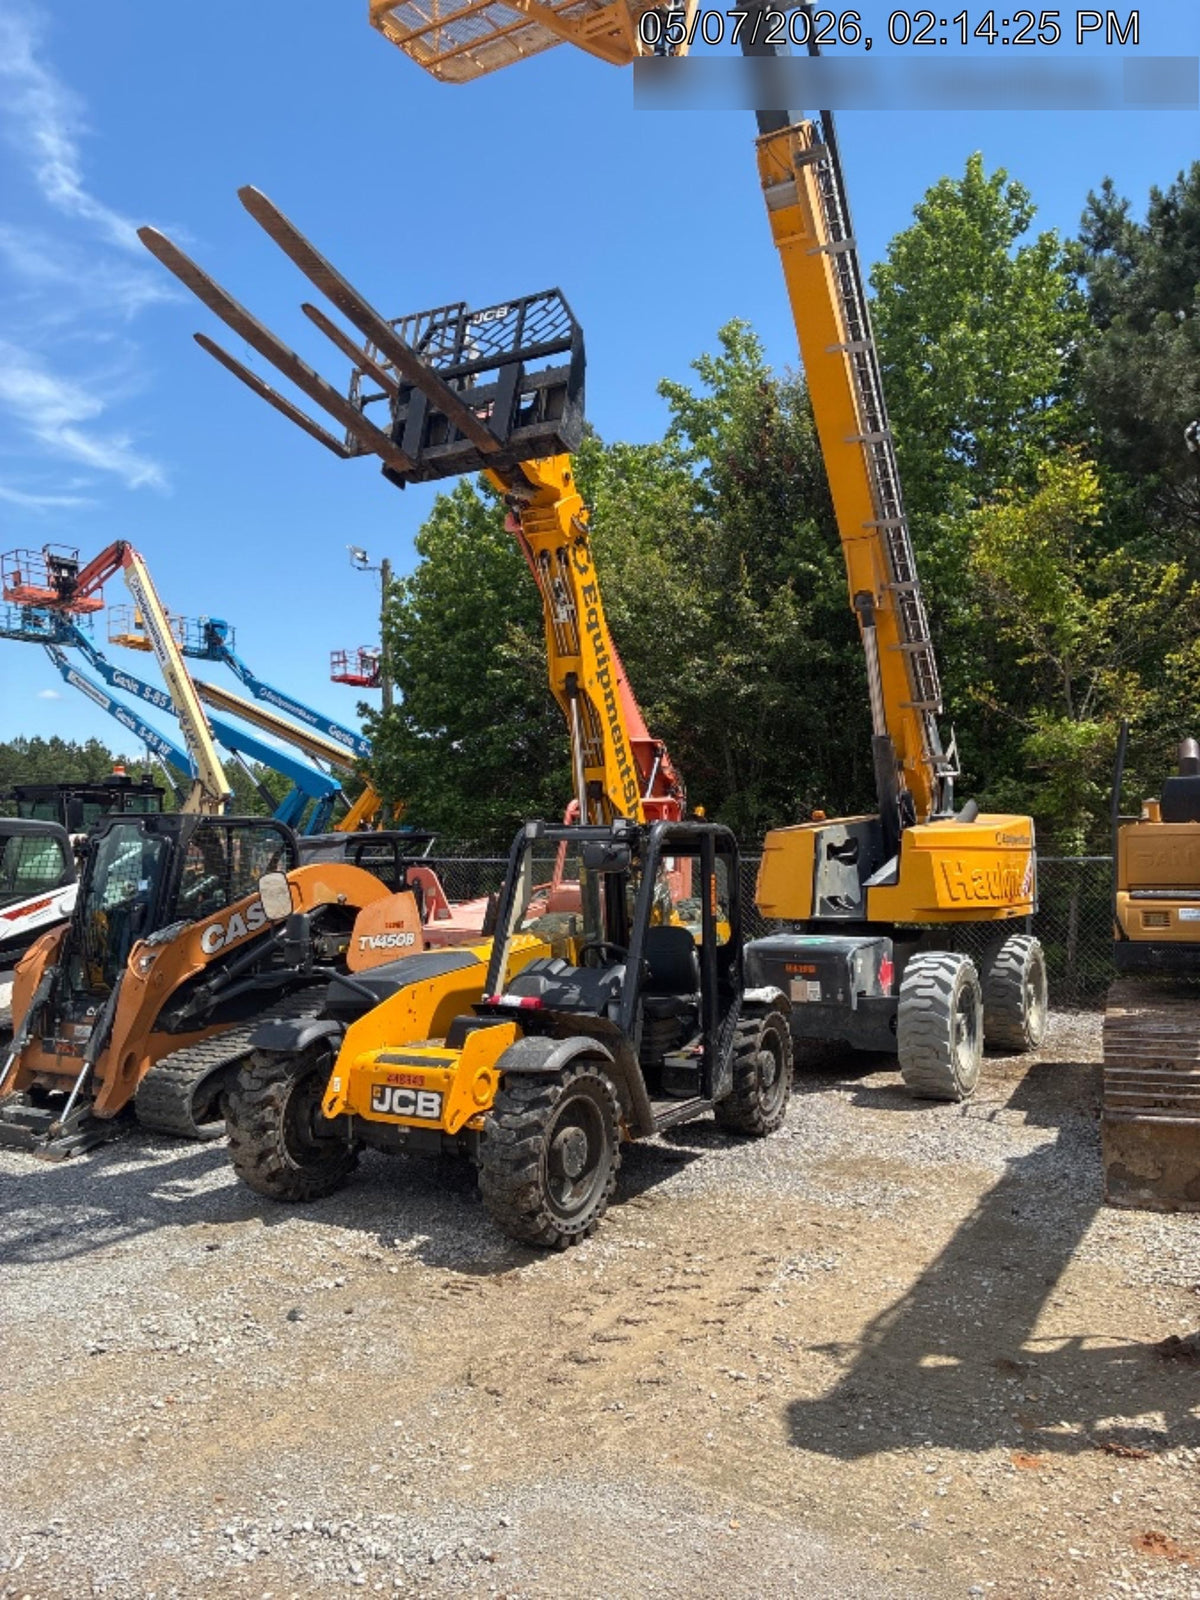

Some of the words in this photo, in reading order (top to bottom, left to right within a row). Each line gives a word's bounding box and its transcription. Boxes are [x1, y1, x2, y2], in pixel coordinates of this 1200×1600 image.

[473, 305, 508, 325] JCB
[113, 670, 139, 693] Genie
[328, 725, 354, 747] Genie
[201, 901, 268, 954] CAS
[358, 932, 415, 951] TV450B
[373, 1087, 441, 1118] JCB
